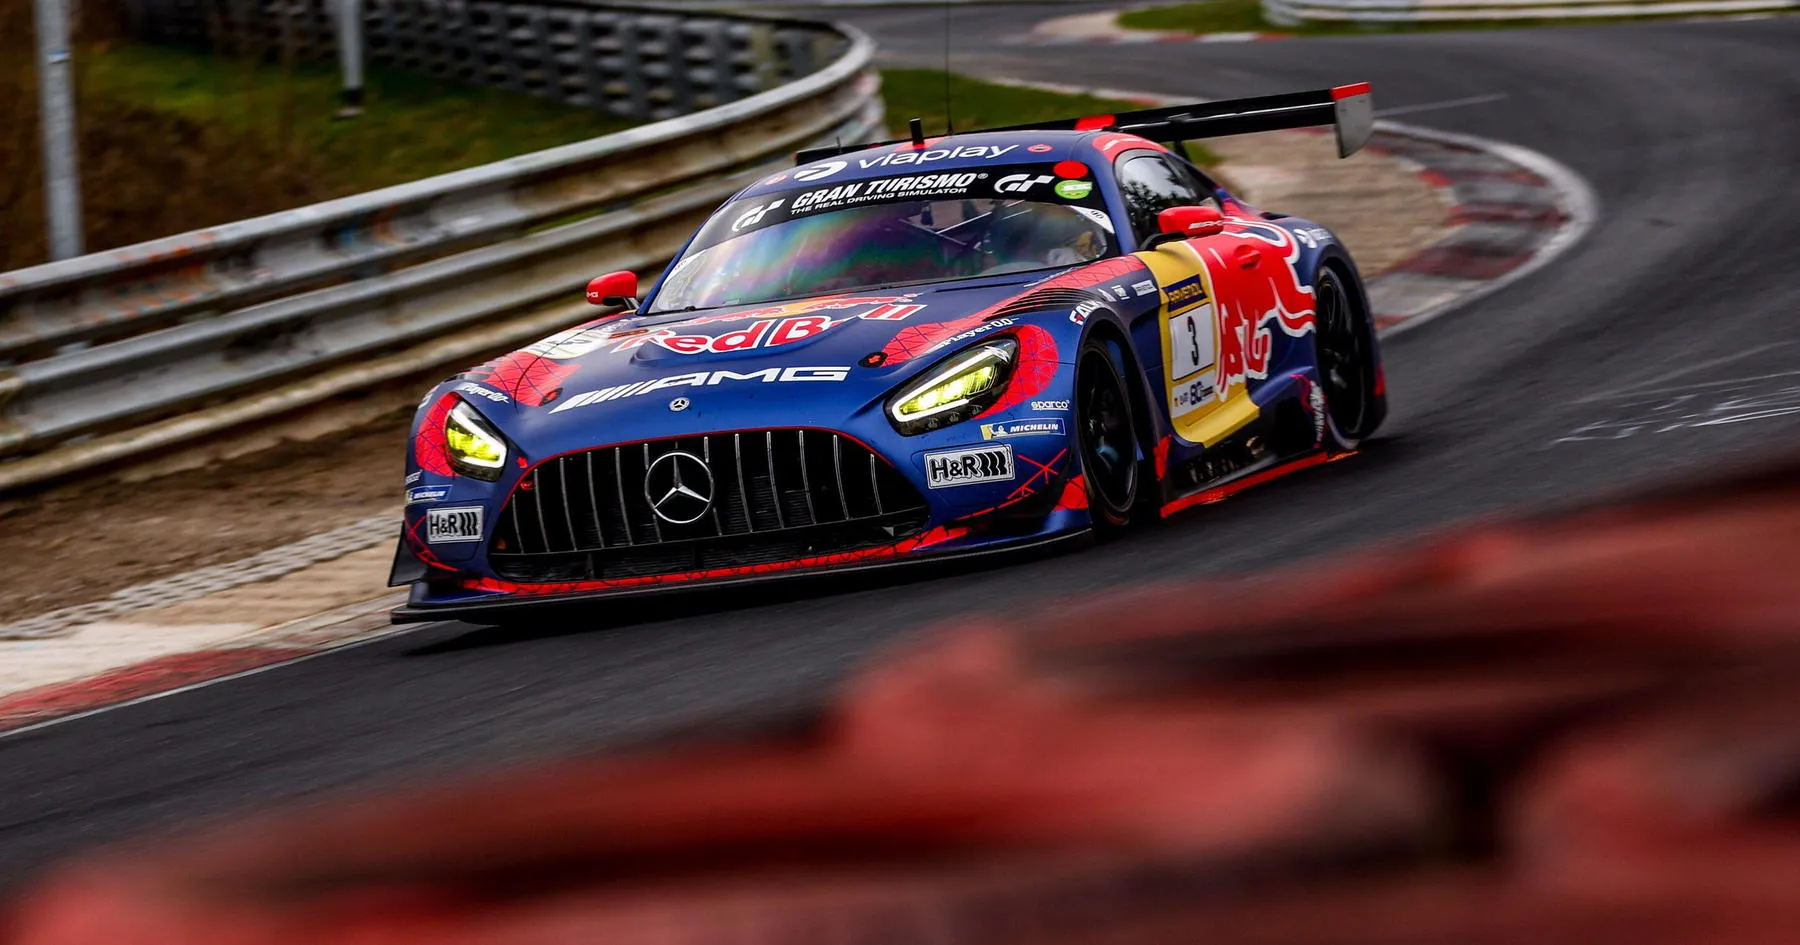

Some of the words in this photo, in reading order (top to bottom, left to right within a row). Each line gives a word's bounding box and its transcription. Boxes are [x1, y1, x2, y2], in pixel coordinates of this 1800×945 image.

[858, 144, 1019, 169] viaplay
[790, 207, 812, 215] THE
[814, 200, 844, 210] REAL
[846, 192, 895, 204] DRIVING
[897, 187, 967, 198] SIMULATOR
[791, 182, 864, 210] GRAN
[610, 318, 778, 355] Red
[1187, 315, 1200, 367] 3
[1030, 400, 1069, 411] sparco
[1010, 423, 1059, 433] MICHELIN
[930, 454, 980, 482] H&R
[430, 512, 458, 536] H&R
